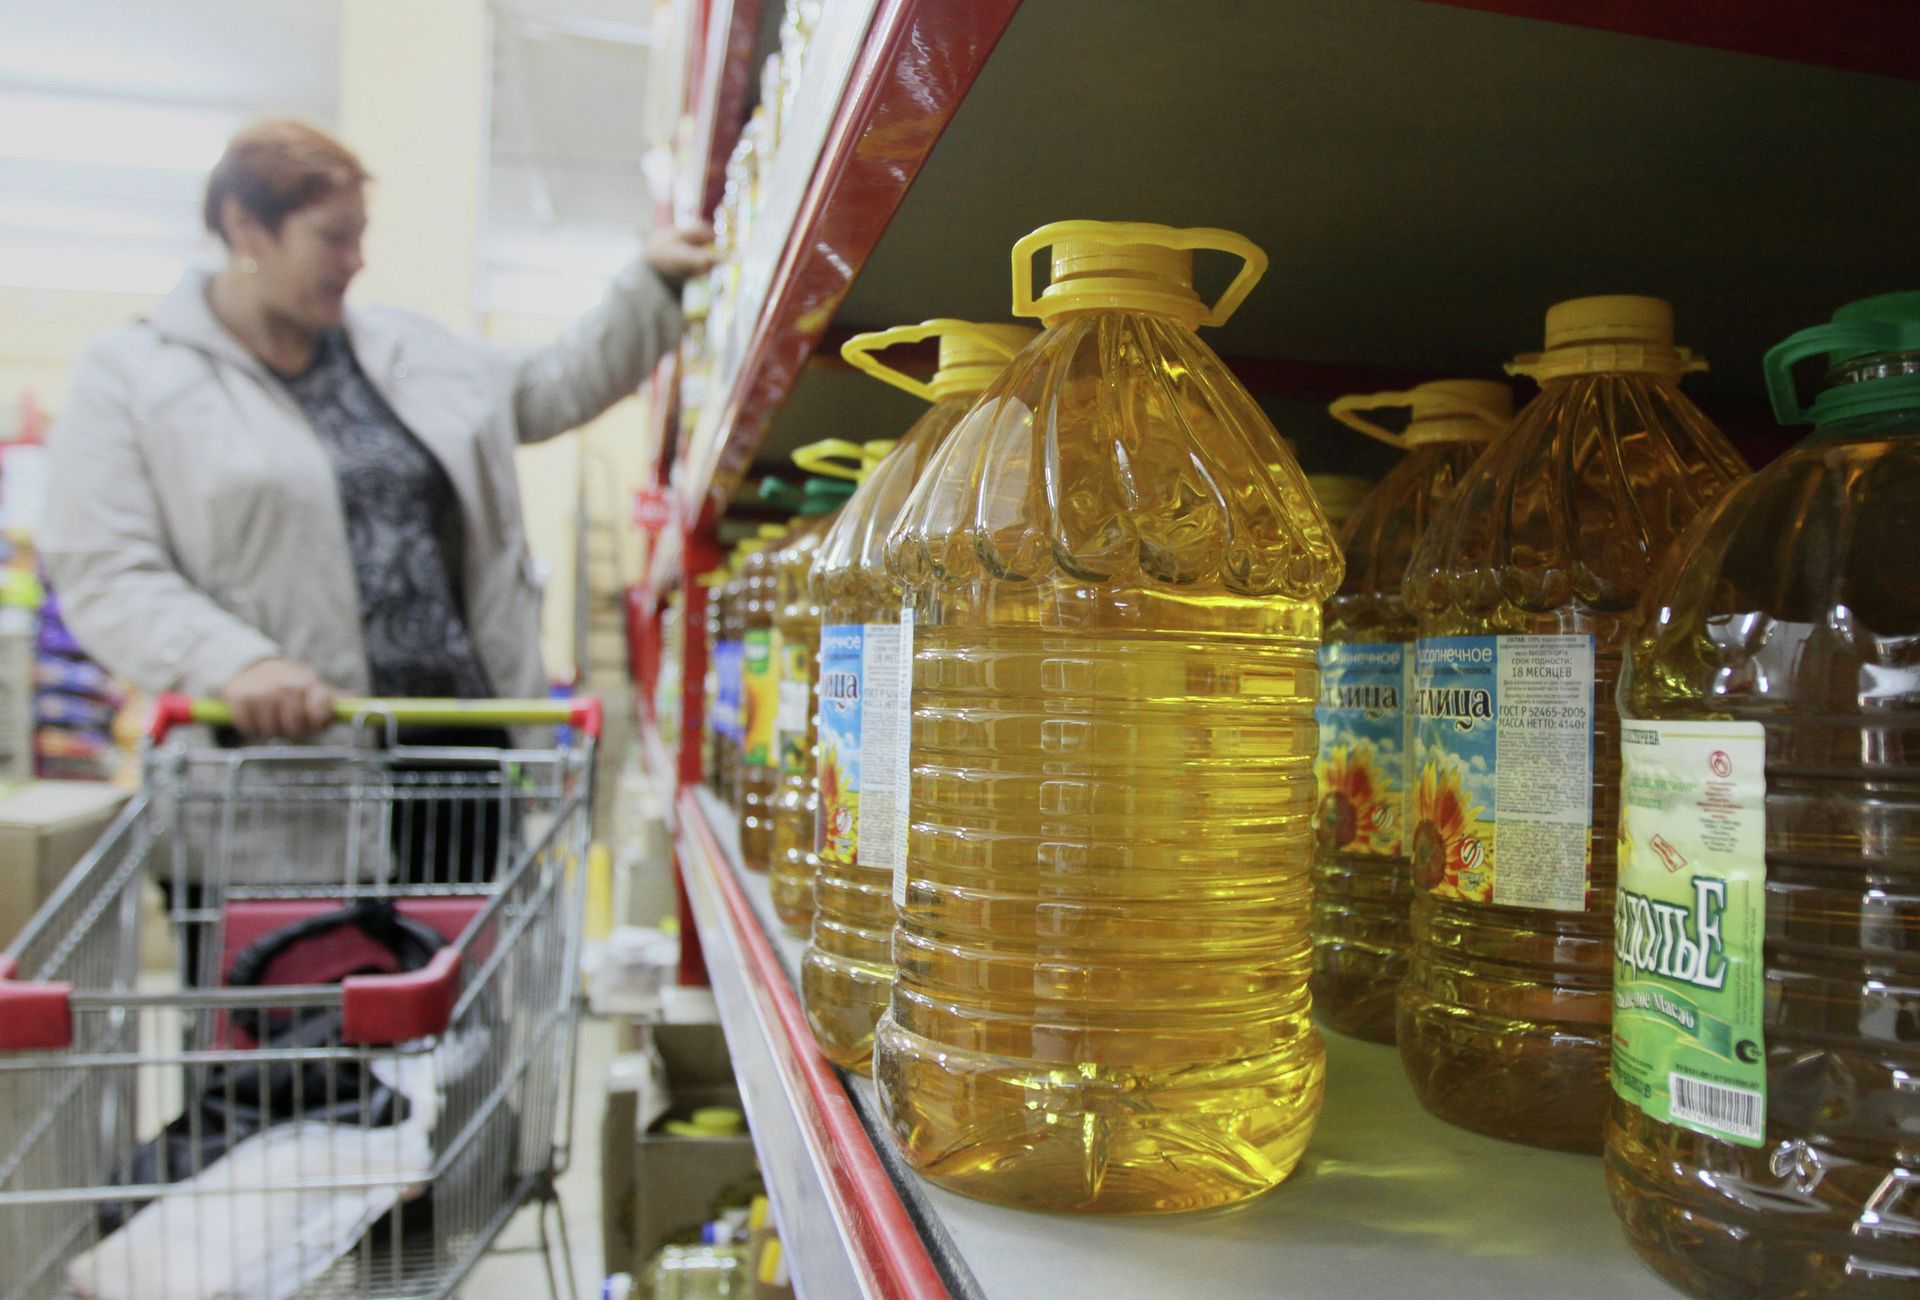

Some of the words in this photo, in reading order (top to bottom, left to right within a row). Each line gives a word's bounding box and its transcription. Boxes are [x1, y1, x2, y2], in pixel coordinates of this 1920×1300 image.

[1512, 667, 1524, 678] 18
[1526, 667, 1572, 679] МЕСЯЦЕВ
[1499, 705, 1519, 717] ГОСТ
[1521, 706, 1527, 717] Р
[1528, 706, 1586, 718] 52465-2005
[1499, 718, 1525, 729] МАССА
[1526, 719, 1557, 729] НЕТТО:
